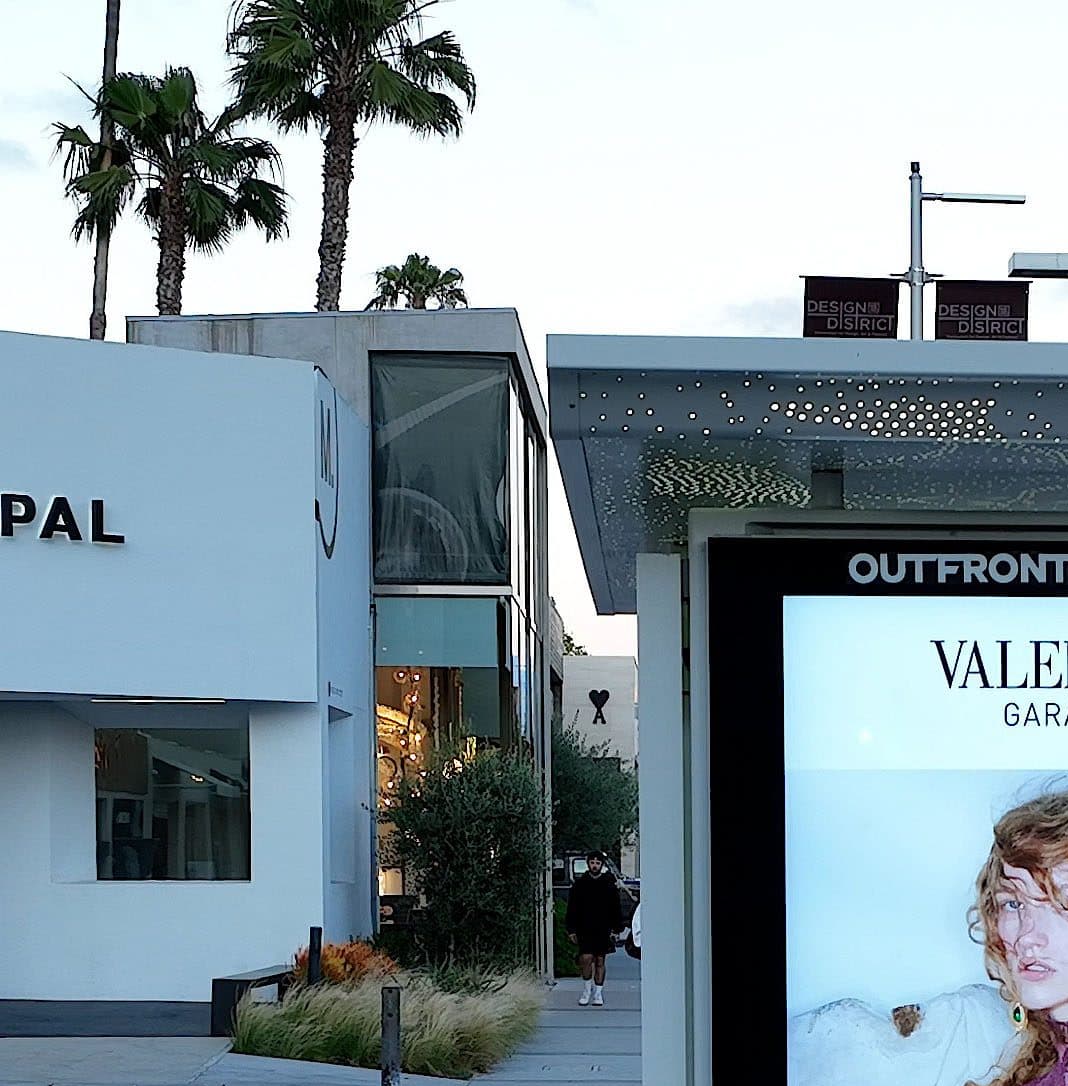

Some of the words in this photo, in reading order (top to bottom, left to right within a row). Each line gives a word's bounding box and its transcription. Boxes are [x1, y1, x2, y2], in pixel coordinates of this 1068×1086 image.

[808, 300, 868, 316] DESIGN
[939, 304, 998, 320] DESIGN
[827, 315, 895, 332] DISTRICT
[959, 318, 1025, 335] DISTRICT
[0, 493, 125, 544] PAL
